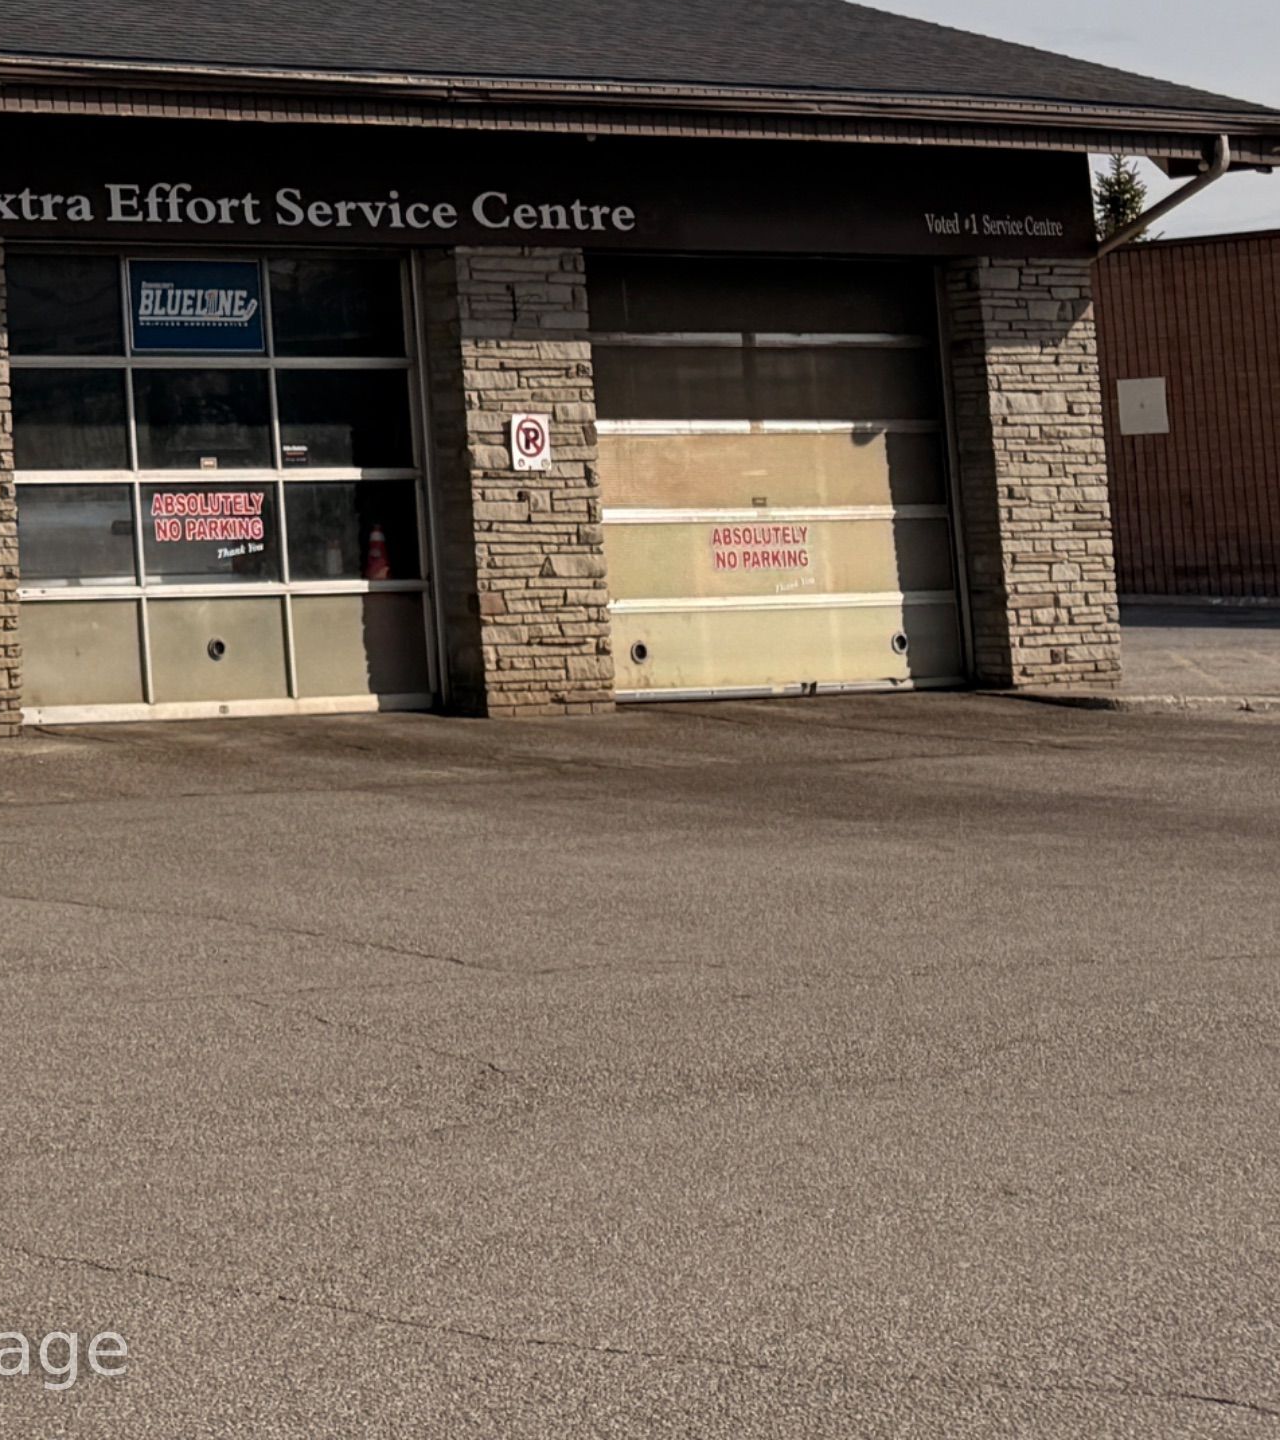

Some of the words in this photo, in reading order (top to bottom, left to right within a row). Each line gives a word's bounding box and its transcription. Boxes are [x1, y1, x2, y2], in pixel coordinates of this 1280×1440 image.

[105, 183, 261, 225] Effort
[275, 187, 458, 228] Service
[472, 191, 636, 231] Centre
[924, 212, 960, 235] Voted
[982, 214, 1023, 236] Service
[1024, 215, 1063, 237] Centre
[151, 492, 264, 516] ABSOLUTELY
[155, 518, 181, 541] NO
[185, 517, 264, 540] PARKING
[713, 526, 808, 545] ABSOLUTELY
[217, 544, 245, 559] Thank
[716, 551, 738, 568] NO
[742, 549, 809, 568] PARKING
